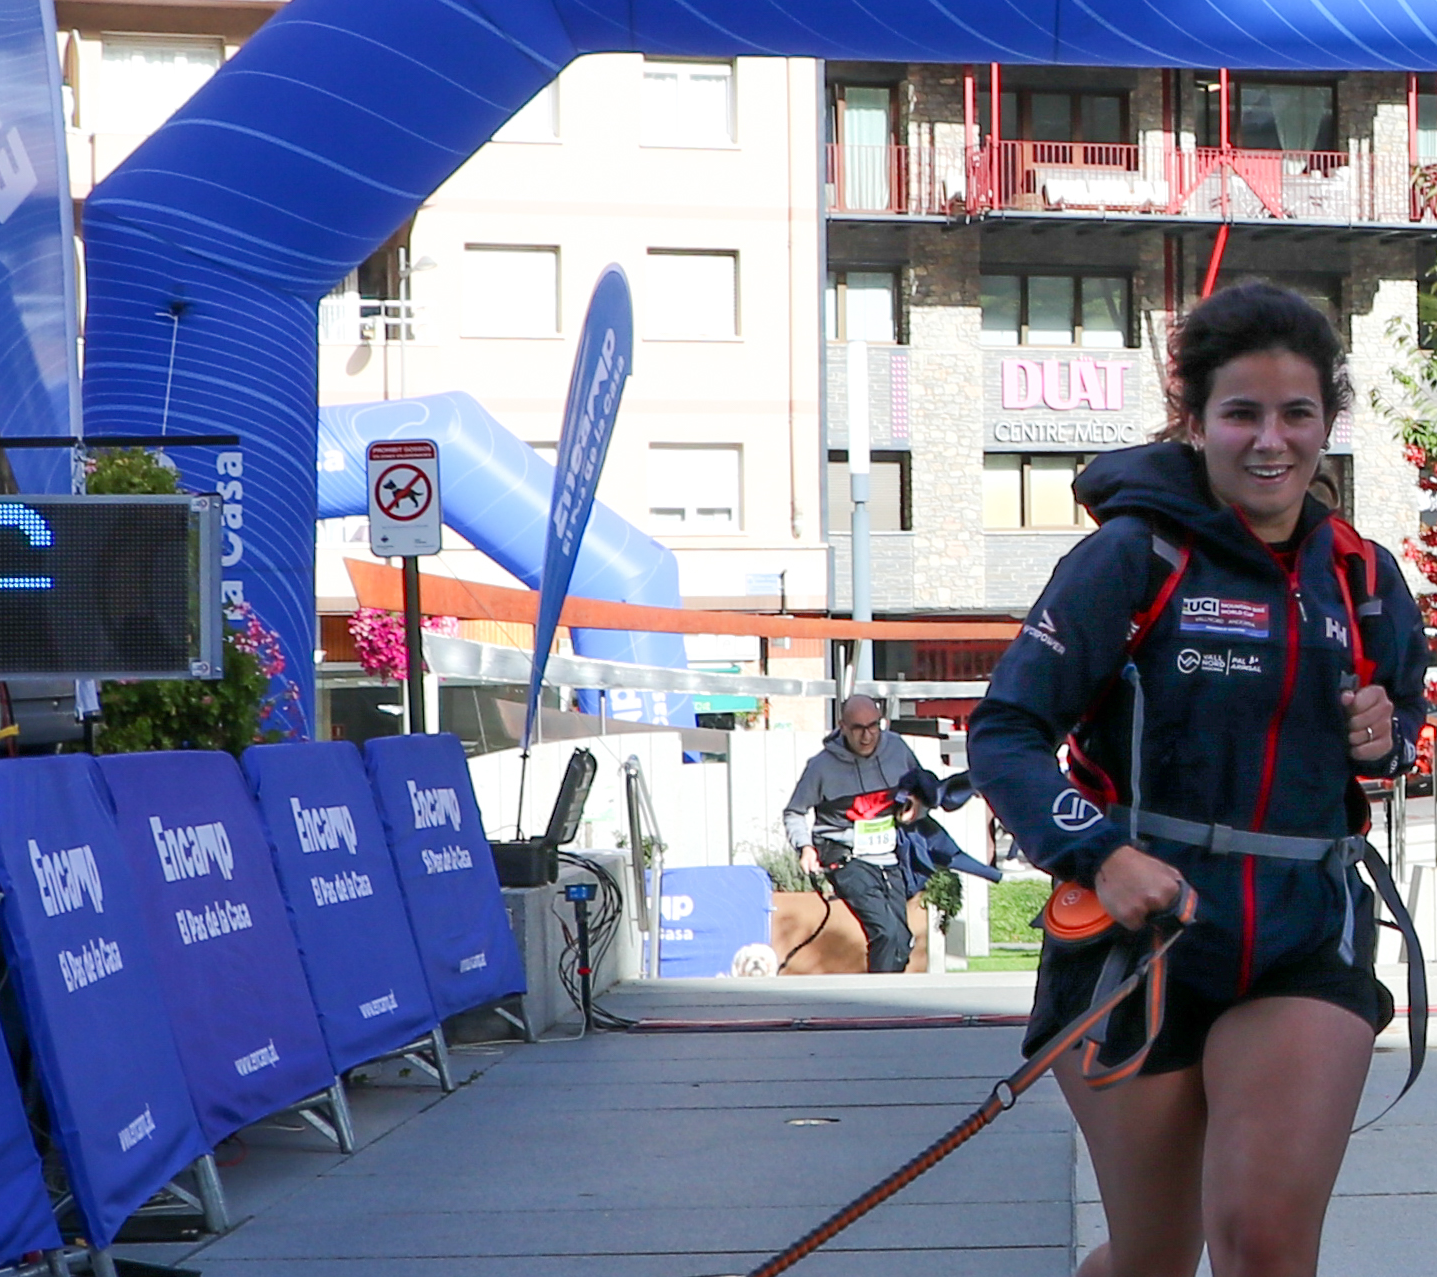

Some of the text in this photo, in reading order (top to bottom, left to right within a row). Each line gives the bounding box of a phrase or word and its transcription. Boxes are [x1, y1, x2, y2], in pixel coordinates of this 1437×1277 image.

[994, 418, 1136, 443] CENTRE MÈDIC
[1190, 600, 1217, 612] UCI
[290, 797, 358, 855] Encamp
[407, 778, 462, 832] Encamp
[149, 816, 235, 882] Encamp
[28, 838, 104, 918] Encamp
